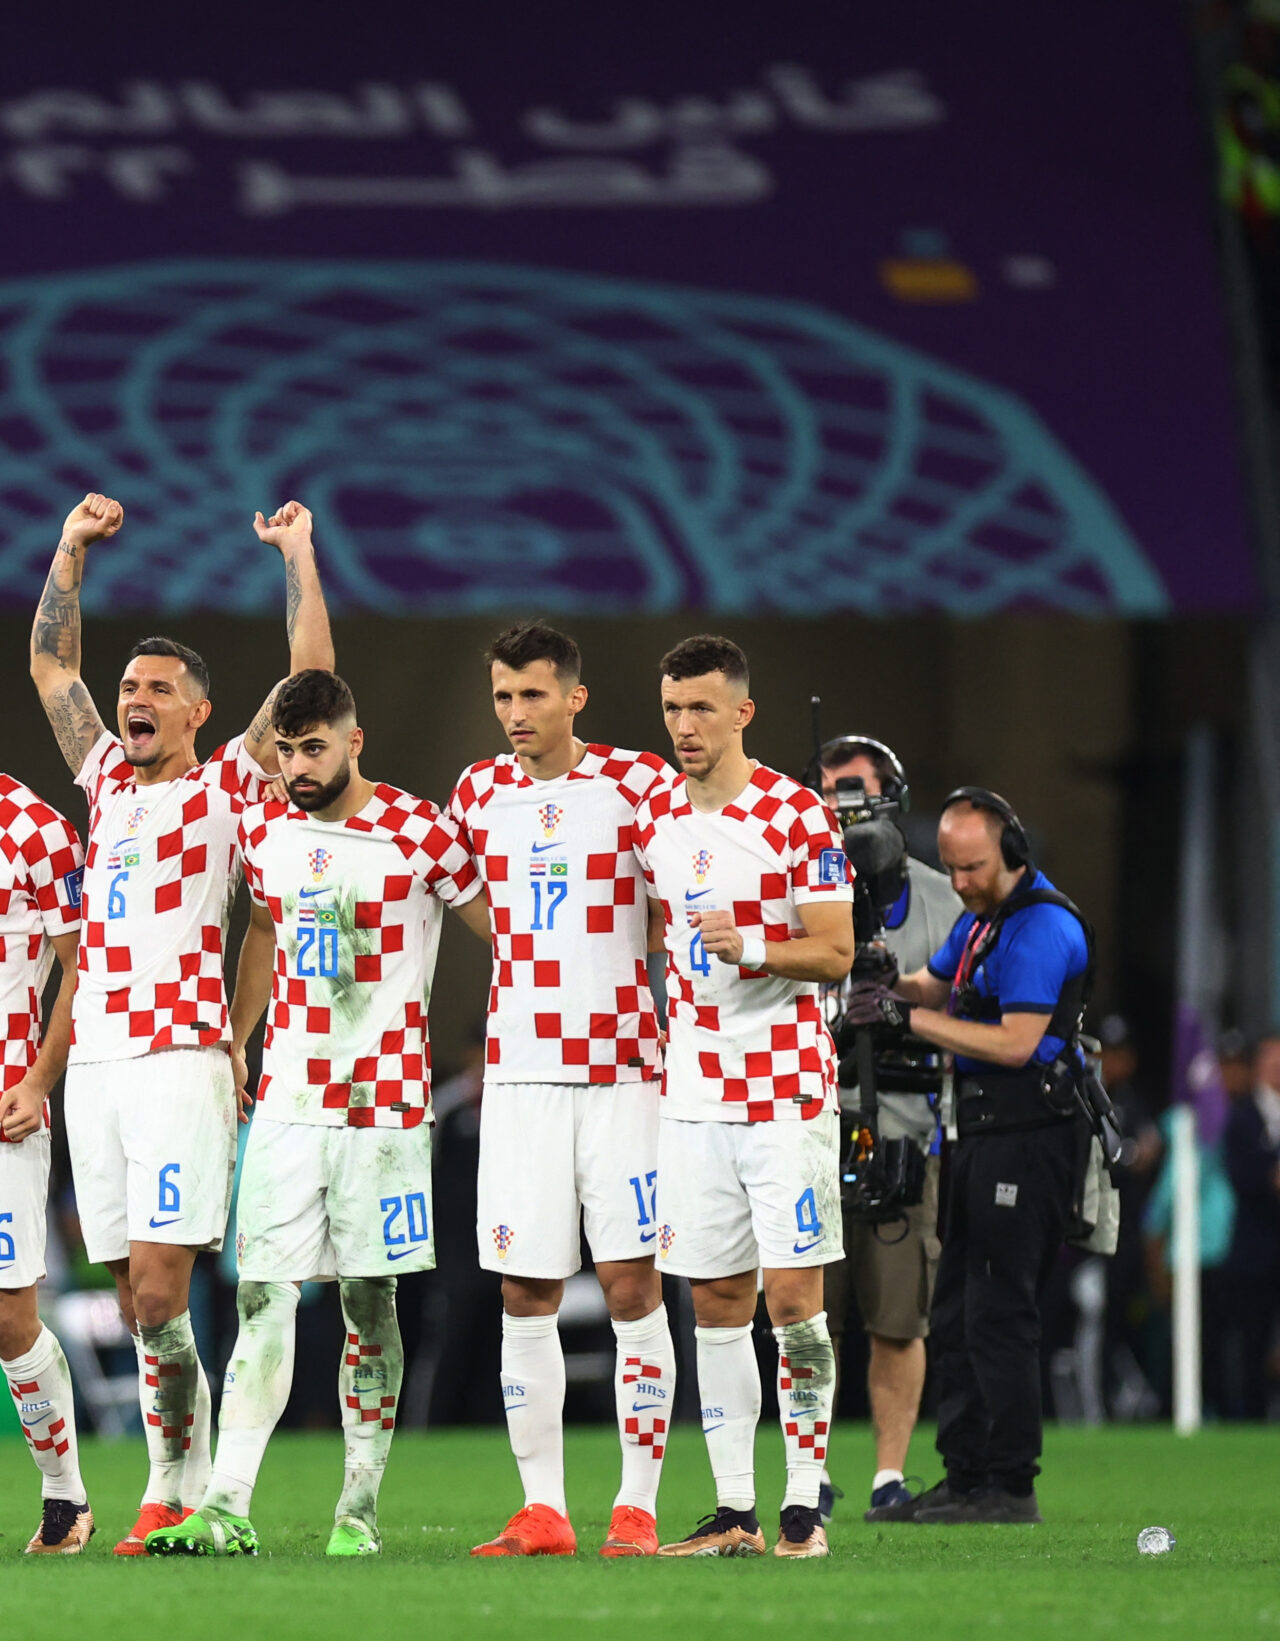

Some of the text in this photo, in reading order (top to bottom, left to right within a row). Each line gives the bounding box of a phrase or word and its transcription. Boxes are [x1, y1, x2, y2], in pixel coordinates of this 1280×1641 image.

[108, 871, 129, 920] 6
[530, 881, 568, 930] 17
[297, 927, 338, 977] 20
[689, 929, 711, 977] 4
[159, 1163, 180, 1212] 6
[795, 1187, 823, 1237] 4
[380, 1192, 429, 1246] 20
